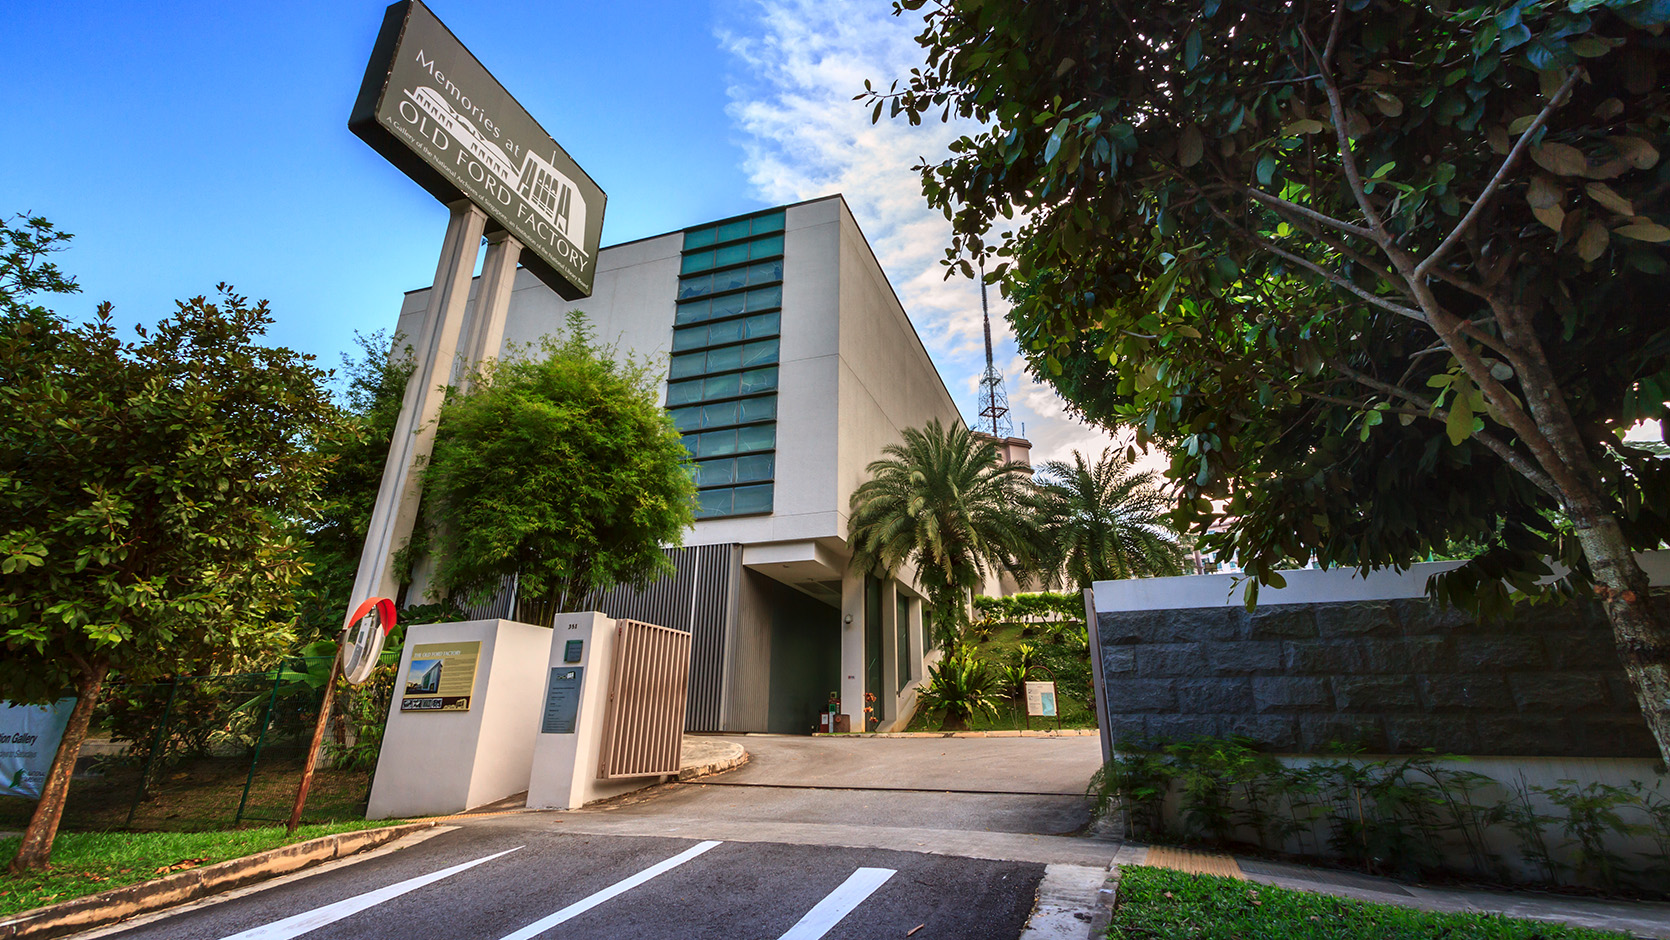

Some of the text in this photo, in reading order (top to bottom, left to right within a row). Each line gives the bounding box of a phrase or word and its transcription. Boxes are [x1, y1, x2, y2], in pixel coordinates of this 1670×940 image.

[416, 49, 520, 158] Memories at
[393, 121, 416, 142] Gallery
[416, 141, 423, 149] of
[422, 144, 432, 156] the
[433, 154, 457, 178] National
[457, 173, 478, 196] Archives
[478, 193, 485, 201] of
[399, 100, 588, 272] OLD FORD FACTORY
[12, 732, 38, 746] Gallery
